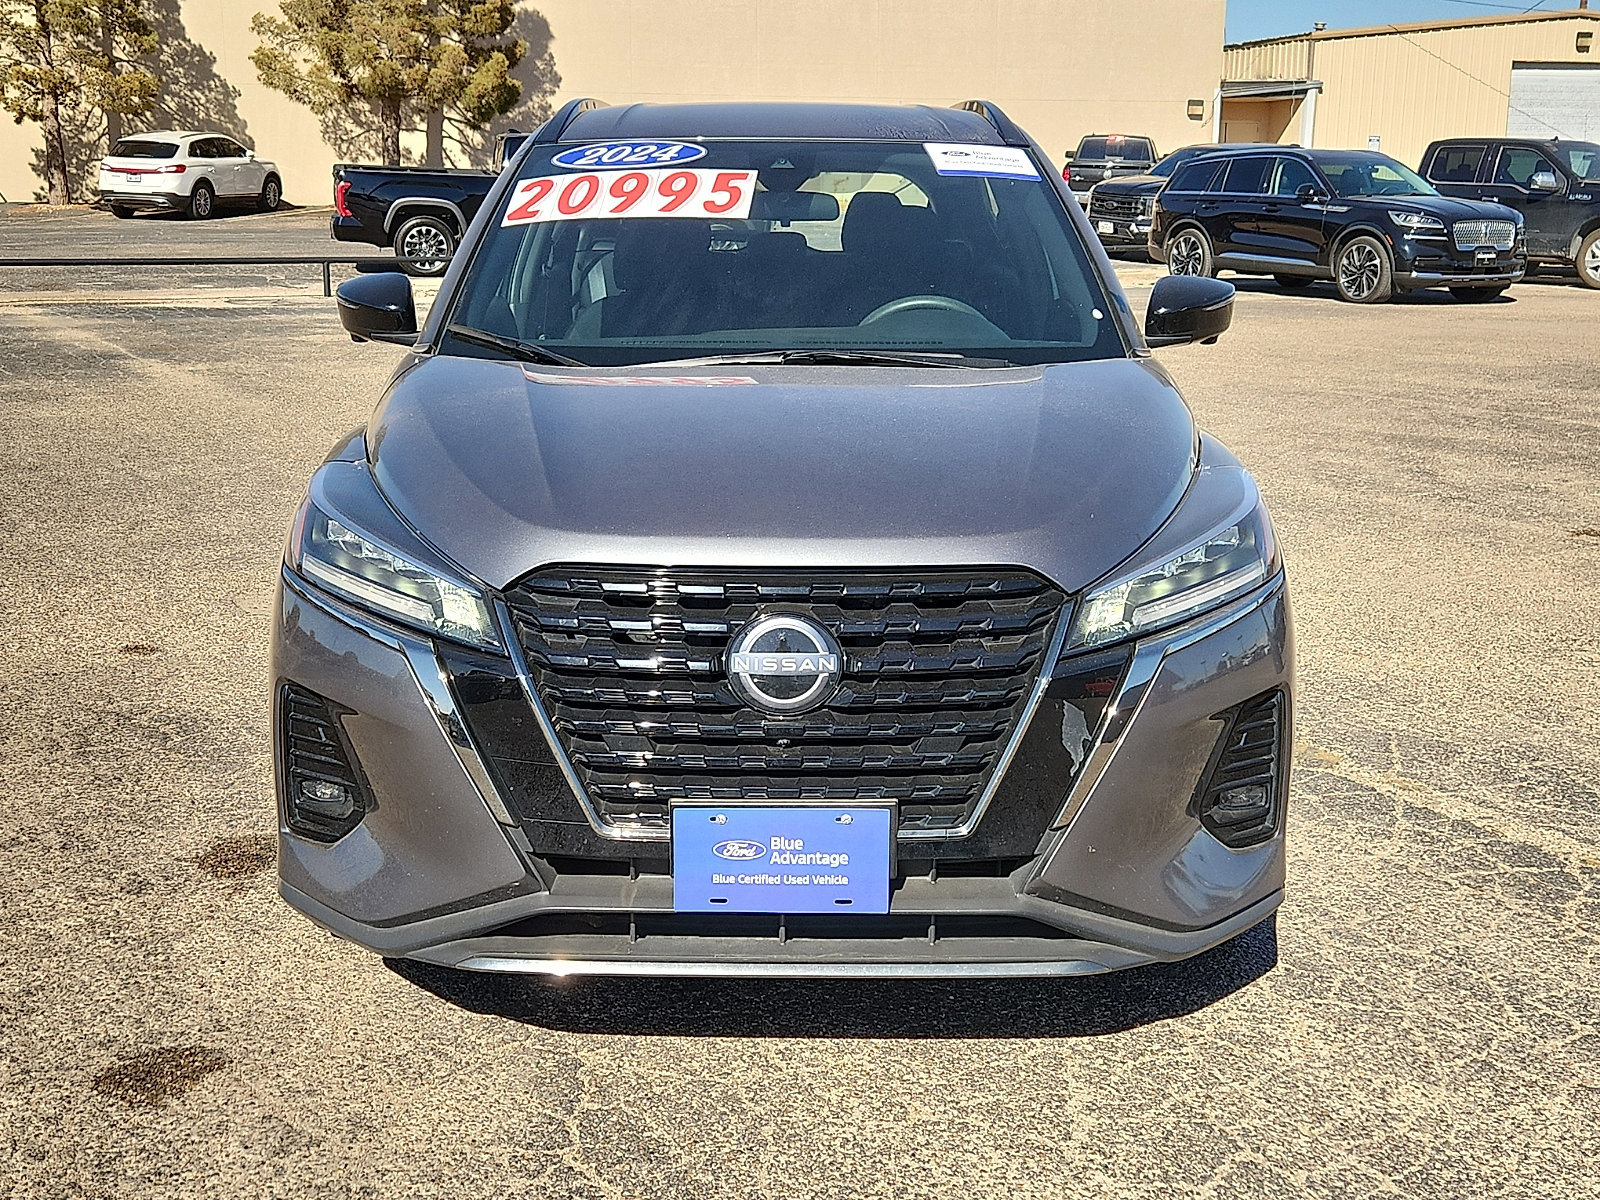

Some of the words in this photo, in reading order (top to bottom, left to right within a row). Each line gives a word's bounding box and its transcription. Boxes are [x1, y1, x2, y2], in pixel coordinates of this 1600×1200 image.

[573, 144, 683, 165] 2024
[507, 171, 750, 221] 20995
[733, 657, 835, 671] NISSAN
[770, 836, 804, 851] Blue
[769, 852, 849, 867] Advantage
[712, 874, 736, 885] Blue
[738, 874, 781, 885] Certified
[783, 874, 809, 885] Used
[812, 874, 849, 886] Vehicle
